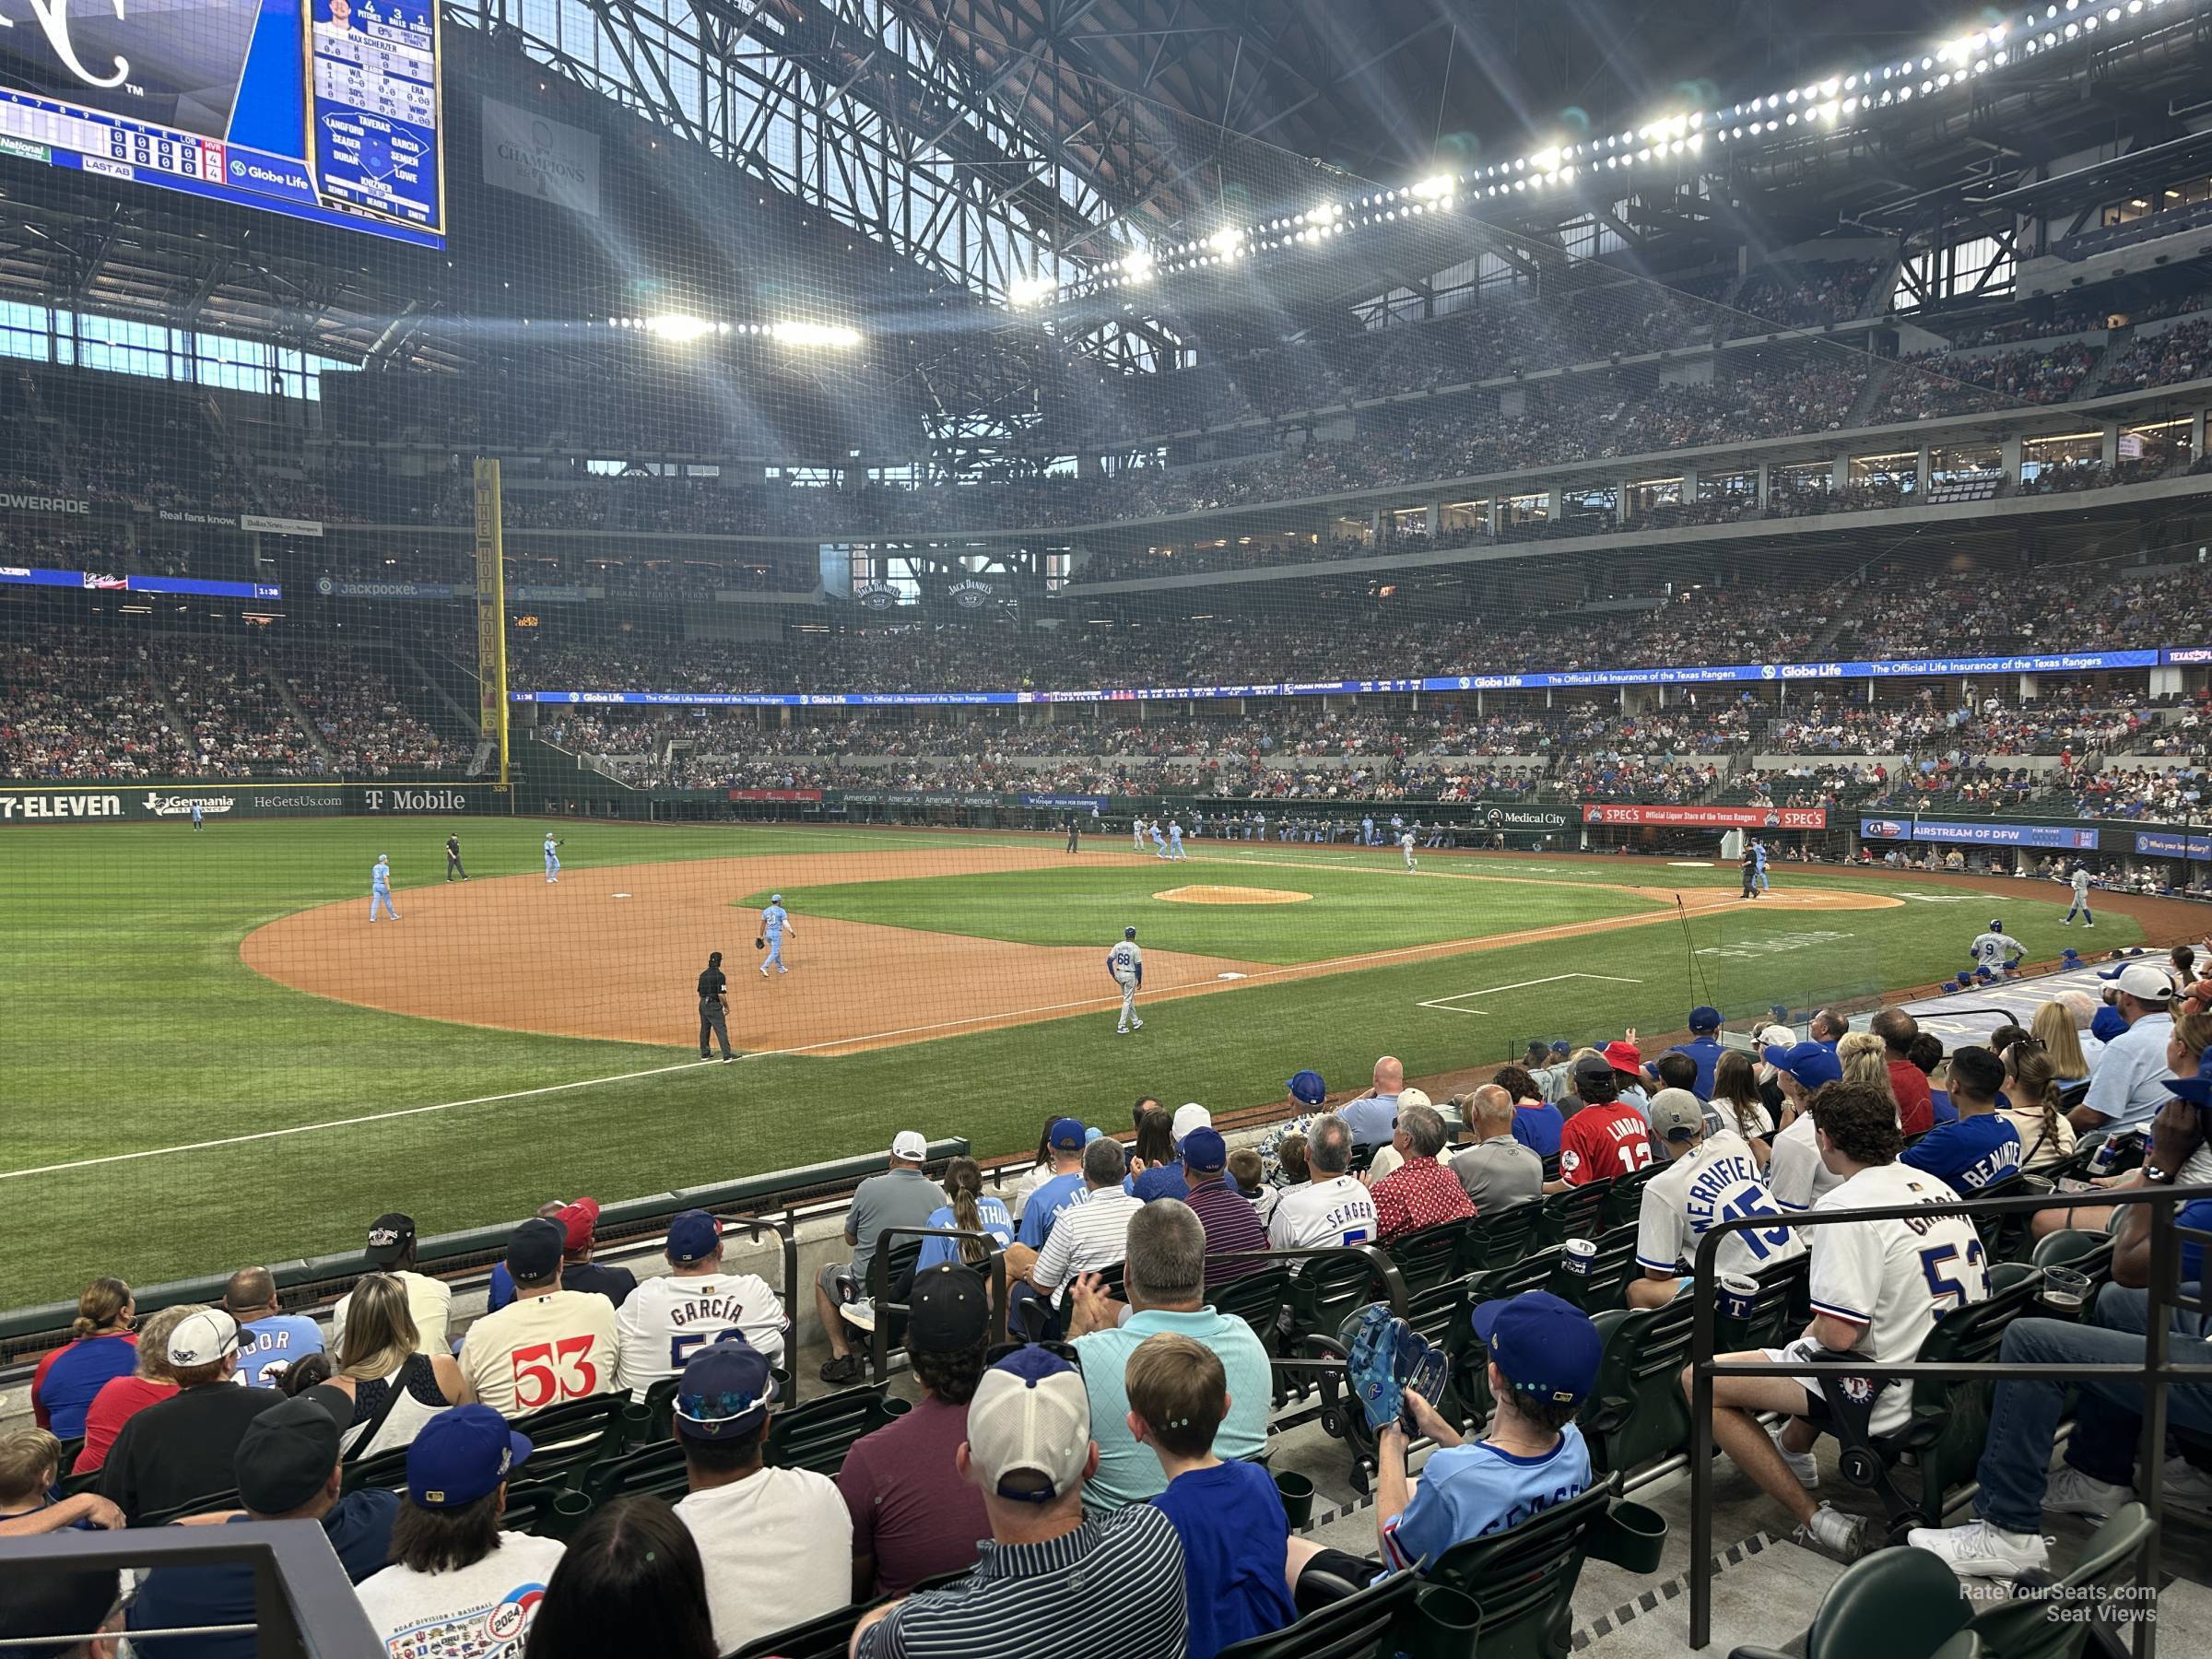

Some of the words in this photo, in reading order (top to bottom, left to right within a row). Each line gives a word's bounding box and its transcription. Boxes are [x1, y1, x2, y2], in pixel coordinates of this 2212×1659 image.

[394, 8, 402, 19] 3
[418, 15, 426, 26] 1
[378, 26, 393, 38] 0%
[324, 45, 341, 55] 0.0
[348, 33, 362, 45] MAX
[363, 37, 397, 53] SCHERZER
[124, 84, 144, 96] TM
[379, 85, 395, 96] 0.0
[348, 96, 366, 107] 0.0
[406, 93, 430, 106] 0.00
[379, 105, 396, 116] 0.0
[409, 105, 428, 116] WHIP
[60, 106, 66, 114] 8
[115, 120, 121, 128] R
[181, 135, 196, 146] LOB
[325, 118, 364, 136] LANGFORD
[358, 115, 391, 133] TAVERAS
[407, 113, 430, 126] 0.00
[1, 136, 44, 155] National
[114, 132, 122, 142] 0
[138, 137, 146, 147] 0
[161, 143, 170, 153] 0
[184, 148, 193, 158] 0
[210, 155, 218, 164] 4
[332, 134, 360, 149] SEAGER
[391, 137, 419, 153] GARCIA
[115, 147, 123, 157] 0
[138, 152, 147, 162] 0
[162, 158, 170, 168] 0
[185, 163, 193, 173] 0
[210, 169, 218, 178] 4
[333, 149, 359, 165] DURAN
[391, 151, 418, 167] SEMIEN
[498, 144, 585, 183] CHAMPIONS
[86, 159, 112, 171] LAST
[115, 167, 130, 176] AB
[394, 166, 418, 183] LOWE
[249, 166, 284, 183] Globe
[286, 173, 308, 190] Life
[360, 176, 393, 194] KNIZNER
[408, 210, 427, 221] SMITH
[159, 510, 182, 521] Real
[184, 512, 206, 524] fans
[207, 514, 237, 526] know.
[479, 490, 488, 535] THE
[481, 547, 490, 592] HOT
[856, 584, 873, 598] JACK
[948, 581, 965, 596] JACK
[484, 606, 492, 665] ZONE
[1782, 665, 1817, 677] Globe
[1818, 664, 1841, 677] Life
[1872, 665, 1889, 674] The
[1892, 663, 1926, 673] Official
[1929, 663, 1947, 672] Life
[1950, 661, 1998, 671] Insurance
[2002, 659, 2012, 669] of
[2015, 659, 2031, 669] the
[2033, 658, 2060, 668] Texas
[2062, 656, 2101, 669] Rangers
[1475, 677, 1503, 688] Globe
[1504, 677, 1522, 687] Life
[1547, 676, 1562, 685] The
[1564, 675, 1591, 684] Official
[1593, 674, 1607, 682] Life
[1609, 673, 1648, 682] Insurance
[1649, 672, 1658, 681] of
[1659, 671, 1675, 680] the
[1677, 671, 1700, 679] Texas
[1701, 670, 1735, 681] Rangers
[583, 693, 606, 703] Globe
[609, 693, 624, 702] Life
[493, 785, 507, 794] 326
[170, 795, 235, 807] Germania
[254, 795, 342, 808] HeGetsUs.com
[365, 791, 383, 809] T
[393, 790, 465, 809] Mobile
[844, 794, 876, 803] American
[888, 795, 913, 804] American
[925, 796, 952, 805] American
[964, 796, 992, 805] American
[1036, 795, 1053, 806] Kroger
[1505, 812, 1542, 823] Medical
[1545, 813, 1566, 826] City
[1606, 808, 1640, 820] SPEC'S
[1645, 811, 1665, 819] Official
[1666, 812, 1683, 821] Liquor
[1684, 812, 1699, 820] Store
[1700, 812, 1705, 820] of
[1706, 812, 1716, 820] the
[1717, 812, 1733, 821] Texas
[1734, 812, 1757, 822] Rangers
[1784, 811, 1822, 825] SPEC'S
[1913, 827, 1972, 838] AIRSTREAM
[1975, 830, 1991, 838] OF
[1993, 830, 2020, 840] DFW
[2149, 841, 2164, 849] Who's
[2165, 842, 2177, 852] your
[1986, 944, 1994, 955] 9
[1118, 953, 1130, 966] 68
[1326, 1202, 1371, 1229] SEAGER
[1722, 1185, 1790, 1261] 15
[671, 1295, 744, 1326] GARCÍA
[1729, 1298, 1747, 1317] T
[512, 1335, 597, 1409] 53
[1329, 1419, 1335, 1430] 5
[1853, 1461, 1862, 1476] 7
[416, 1614, 449, 1625] DIVISION
[458, 1602, 493, 1616] BASEBALL
[495, 1606, 521, 1632] 2024
